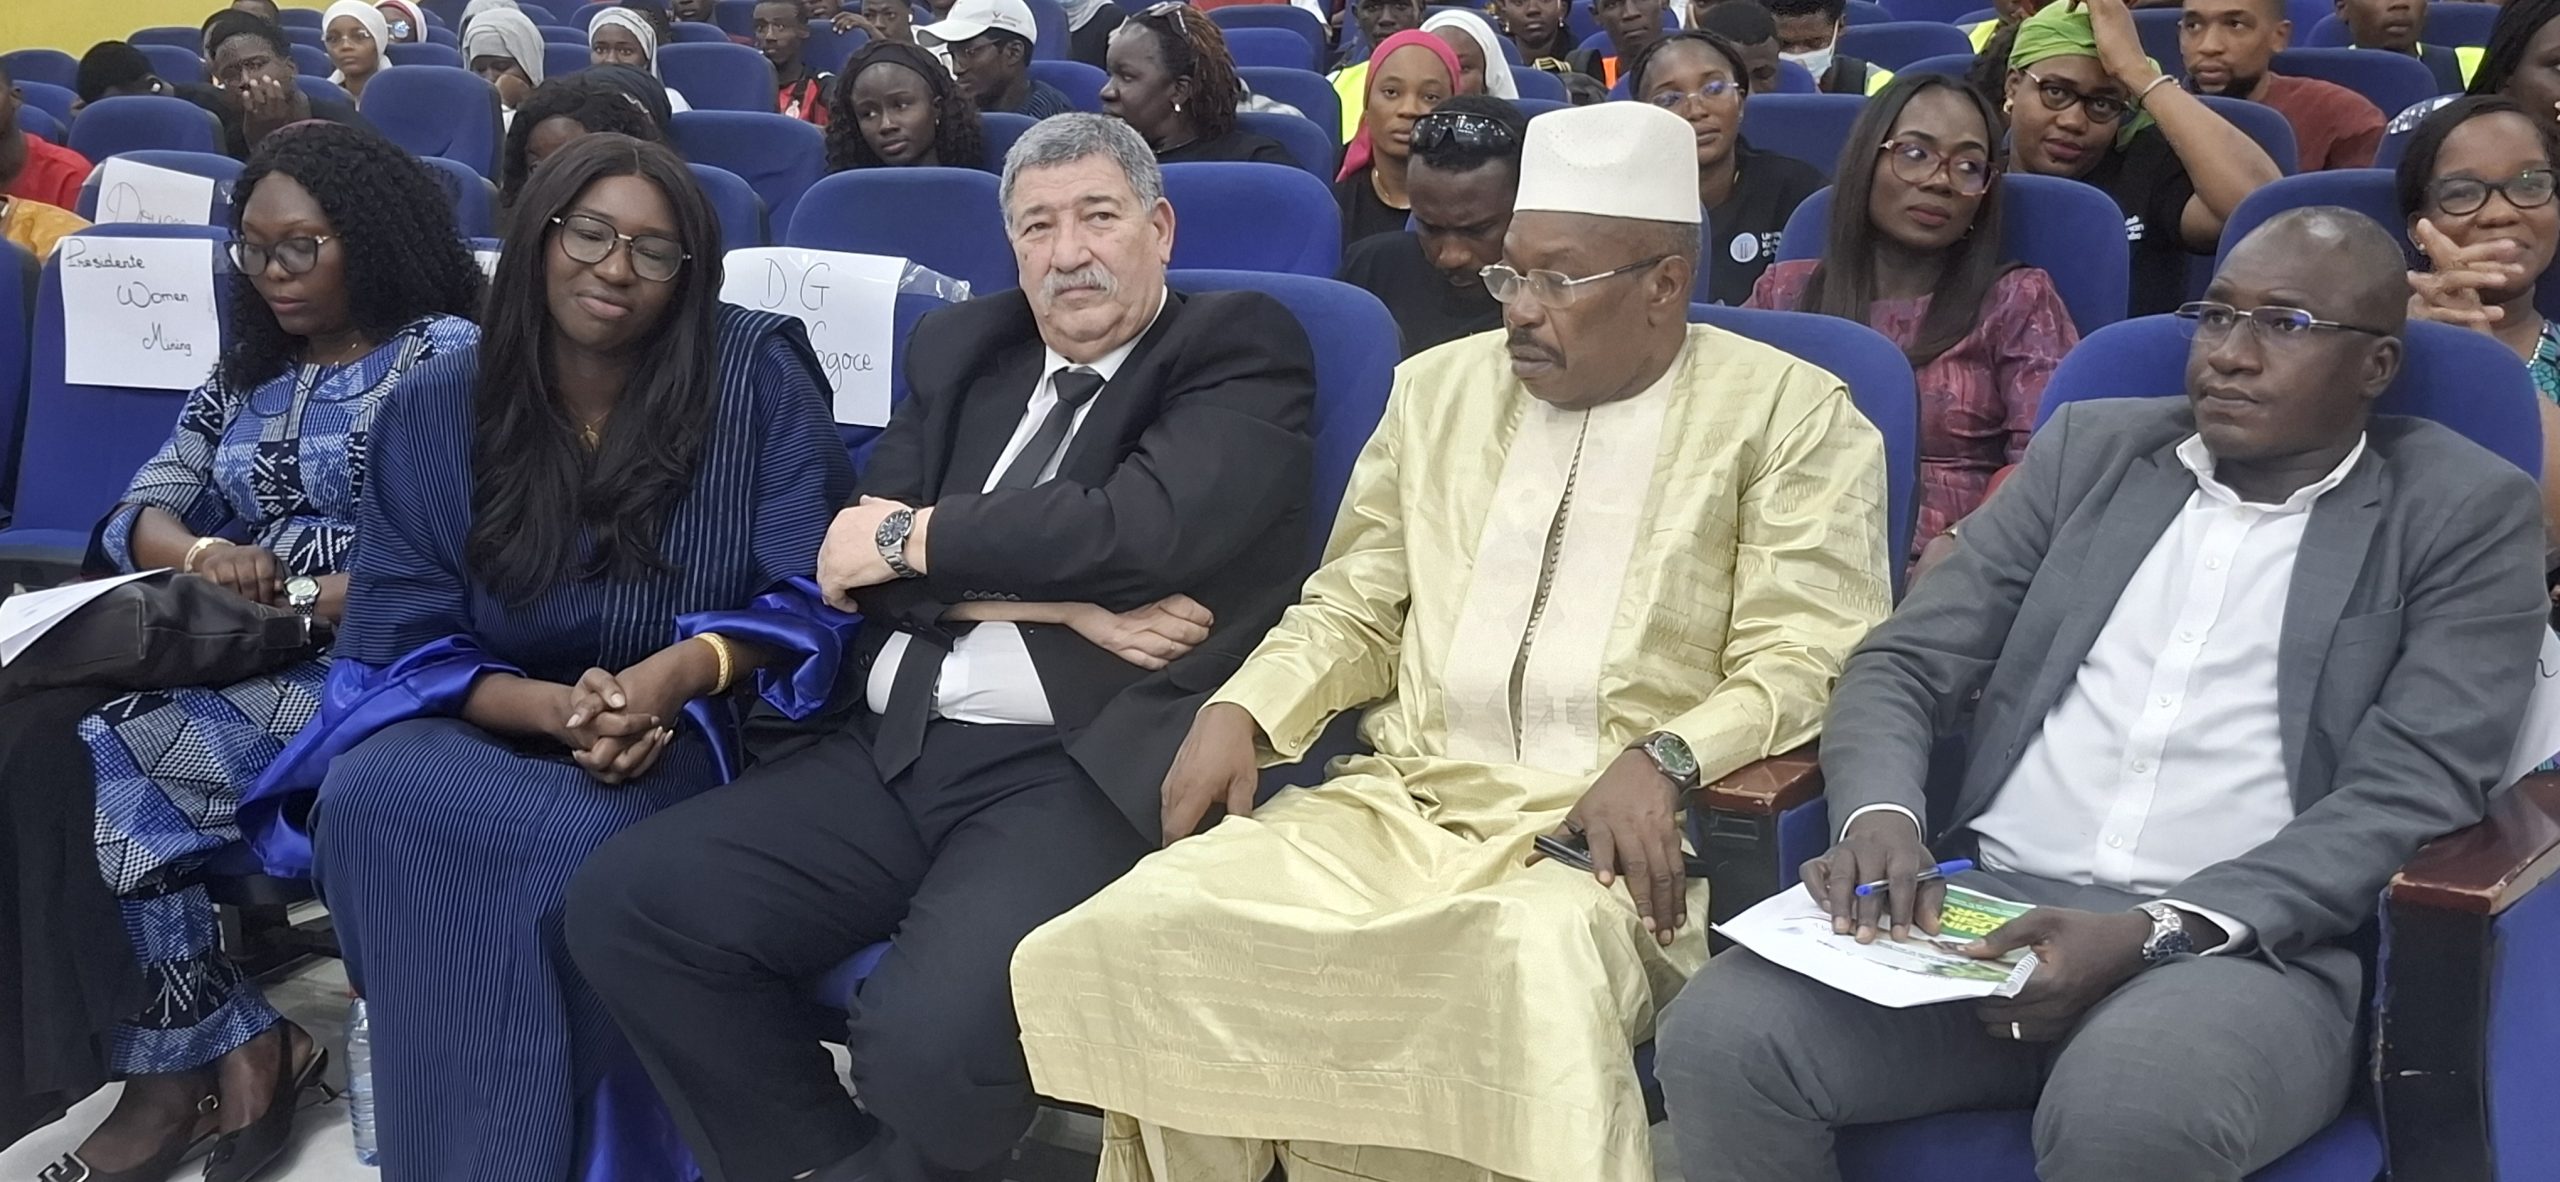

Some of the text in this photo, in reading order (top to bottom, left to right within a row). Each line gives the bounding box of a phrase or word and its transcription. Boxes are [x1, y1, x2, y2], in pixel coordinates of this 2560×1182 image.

[65, 238, 145, 269] Presidente
[117, 281, 189, 308] Women
[142, 321, 192, 357] Mining
